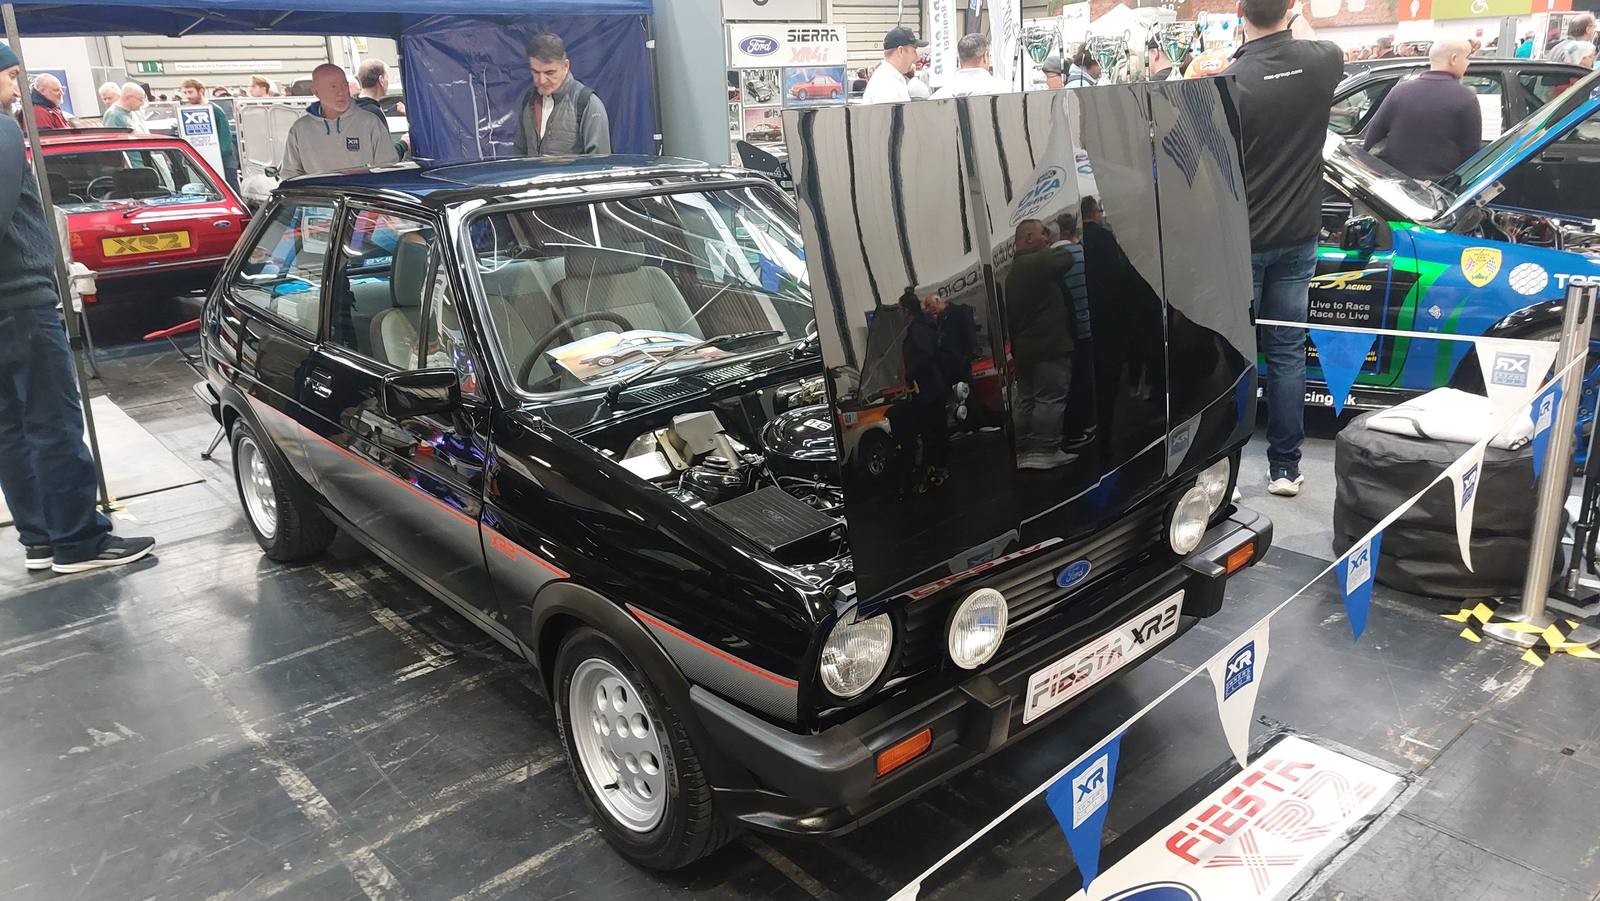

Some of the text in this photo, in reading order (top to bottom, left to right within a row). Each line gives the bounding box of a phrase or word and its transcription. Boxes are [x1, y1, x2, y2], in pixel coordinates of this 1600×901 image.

[746, 38, 773, 53] Ford
[183, 111, 210, 124] XR
[111, 233, 182, 254] XR2
[1310, 300, 1370, 311] Live to Race
[1309, 309, 1370, 321] Race to Live
[1350, 548, 1368, 575] XR
[1227, 649, 1253, 681] XR
[1076, 766, 1104, 804] XR
